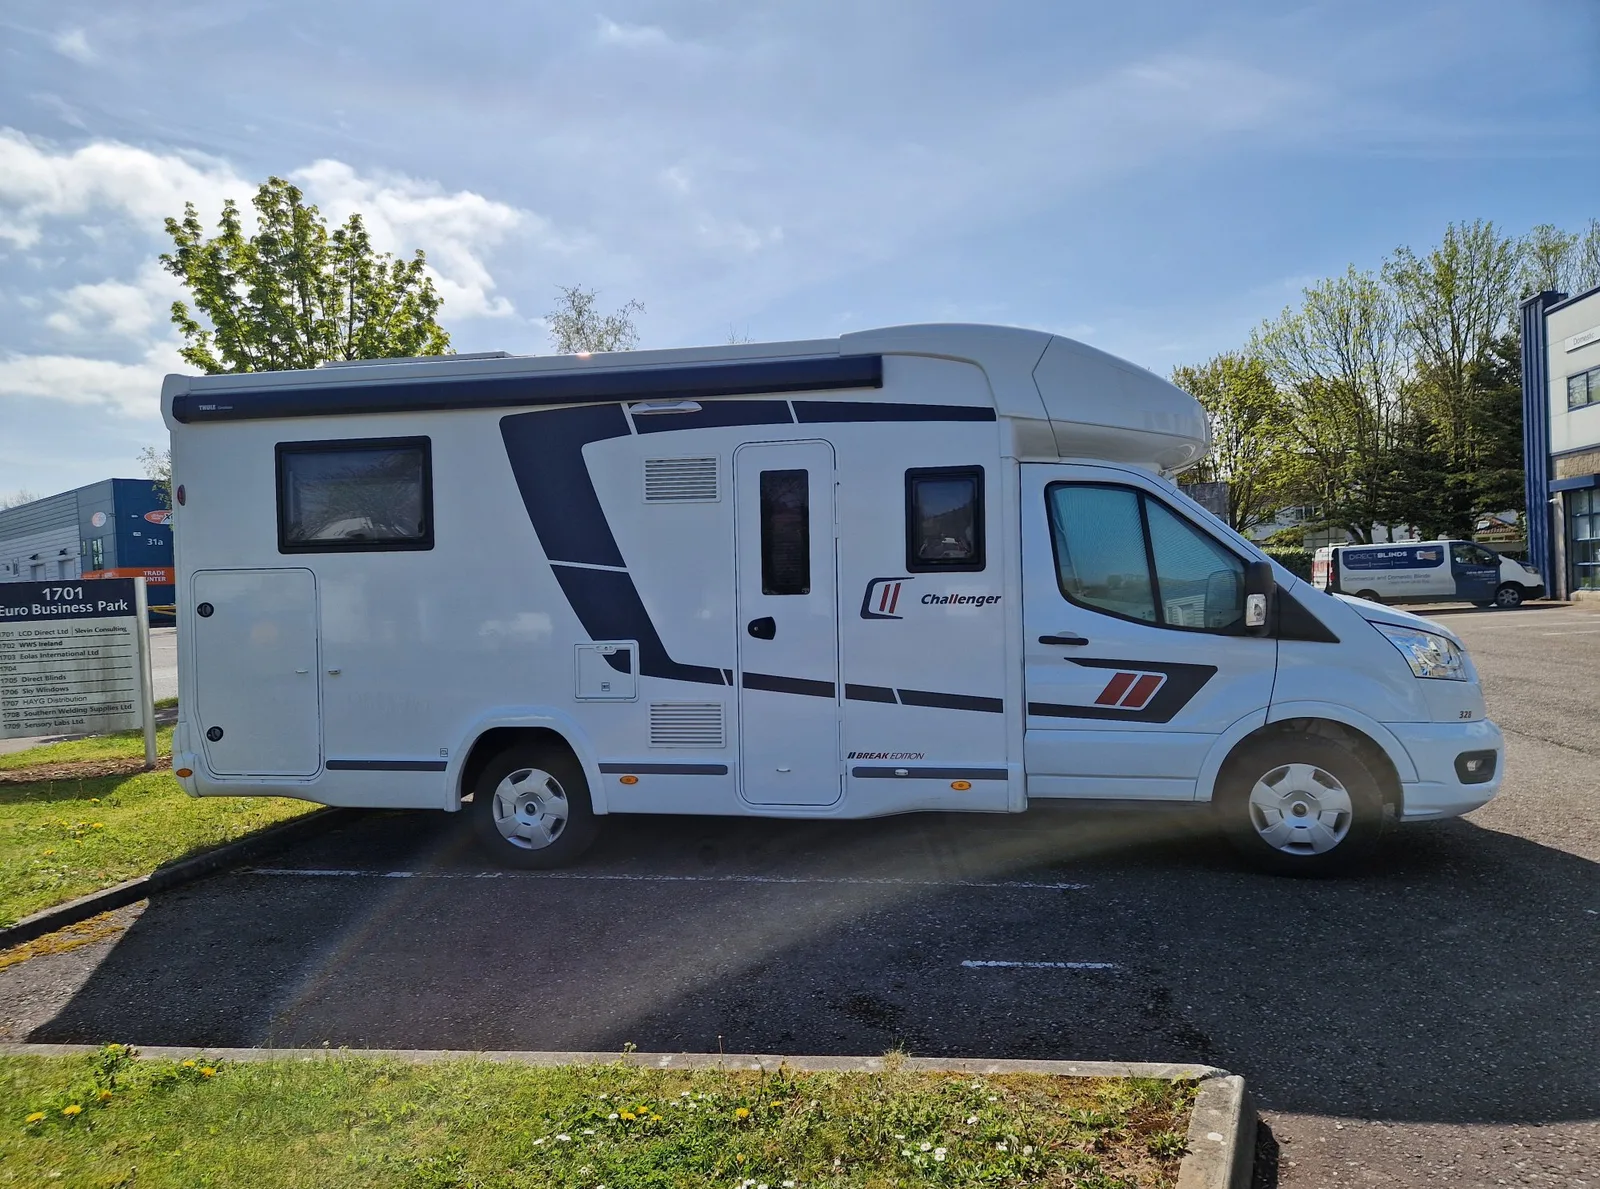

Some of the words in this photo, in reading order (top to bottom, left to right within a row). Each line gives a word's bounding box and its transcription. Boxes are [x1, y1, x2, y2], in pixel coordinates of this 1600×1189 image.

[147, 538, 164, 546] 31a
[42, 586, 83, 600] 1701
[921, 594, 1002, 607] Challenger
[0, 605, 29, 617] Euro
[32, 602, 94, 615] Business
[98, 599, 128, 611] Park
[47, 696, 88, 704] Distribution
[23, 709, 57, 717] Southern
[57, 707, 88, 715] Welding
[89, 705, 120, 713] Supplies
[24, 721, 53, 729] Sensory
[890, 752, 925, 760] EDITION
